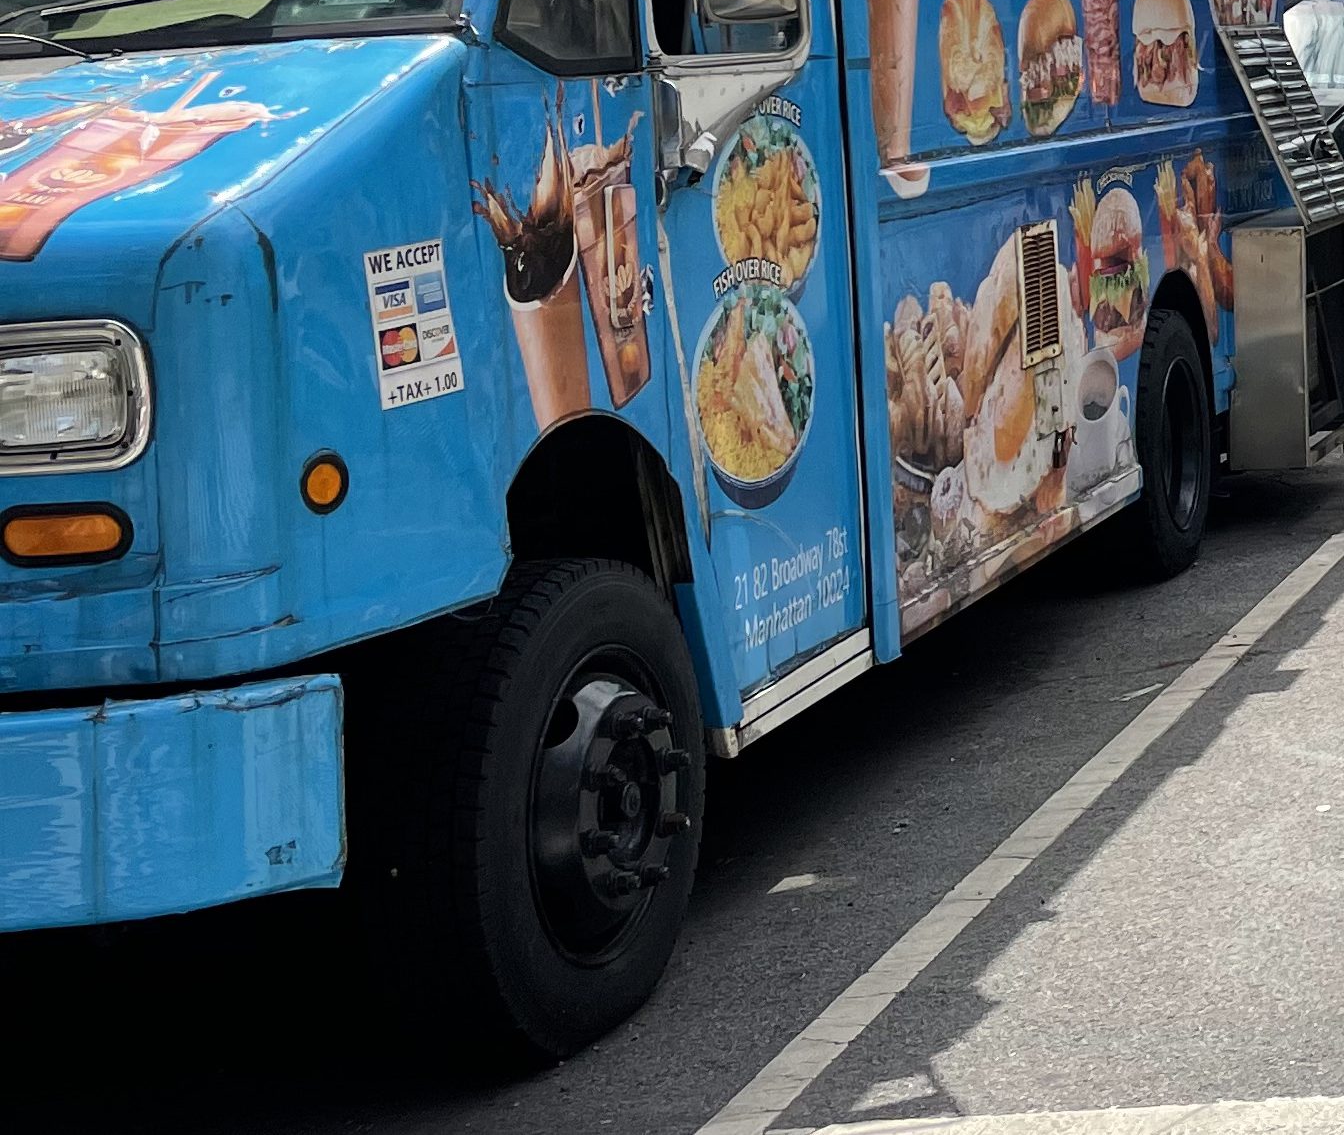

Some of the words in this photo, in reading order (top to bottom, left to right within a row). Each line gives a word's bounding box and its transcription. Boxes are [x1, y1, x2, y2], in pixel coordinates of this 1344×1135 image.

[759, 95, 782, 116] OVER
[782, 99, 801, 126] RICE
[368, 252, 393, 275] WE
[396, 243, 440, 270] ACCEPT
[714, 266, 736, 298] FISH
[736, 258, 760, 282] OVER
[761, 260, 782, 285] RICE
[383, 291, 407, 310] VISA
[734, 571, 749, 611] 21
[752, 562, 769, 601] 82
[771, 542, 824, 591] Broadway
[825, 525, 848, 563] 78st
[745, 592, 812, 654] Manhattan
[816, 564, 850, 612] 10024
